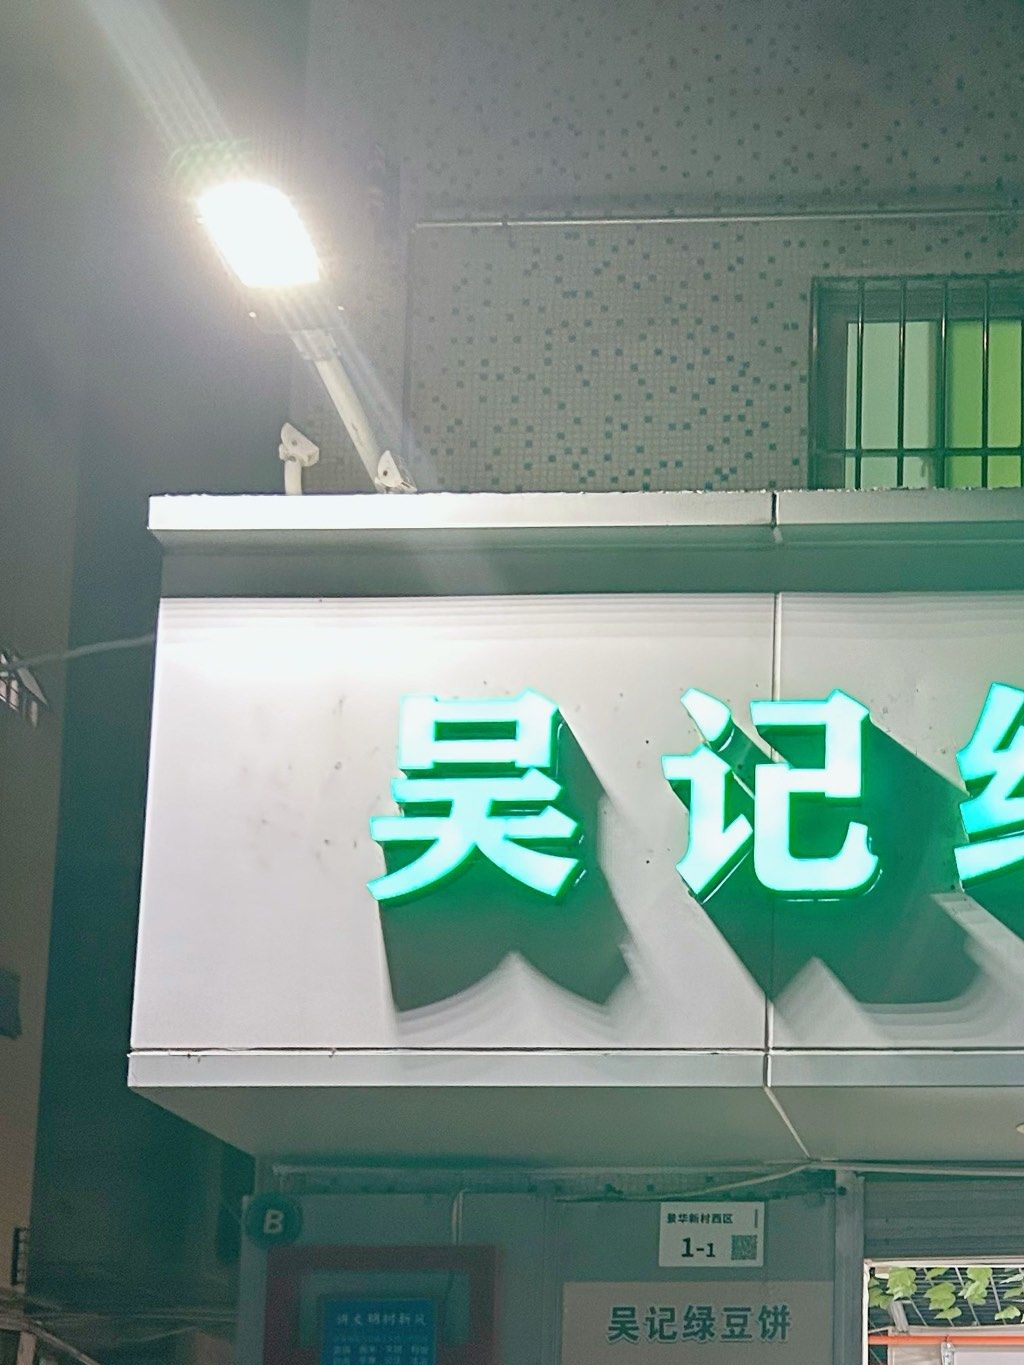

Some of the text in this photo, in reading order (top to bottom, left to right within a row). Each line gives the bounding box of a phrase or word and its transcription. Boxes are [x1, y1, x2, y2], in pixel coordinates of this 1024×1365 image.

[264, 1209, 285, 1234] B
[681, 1237, 716, 1258] 1-1
[607, 1304, 792, 1344] 吴记绿豆饼
